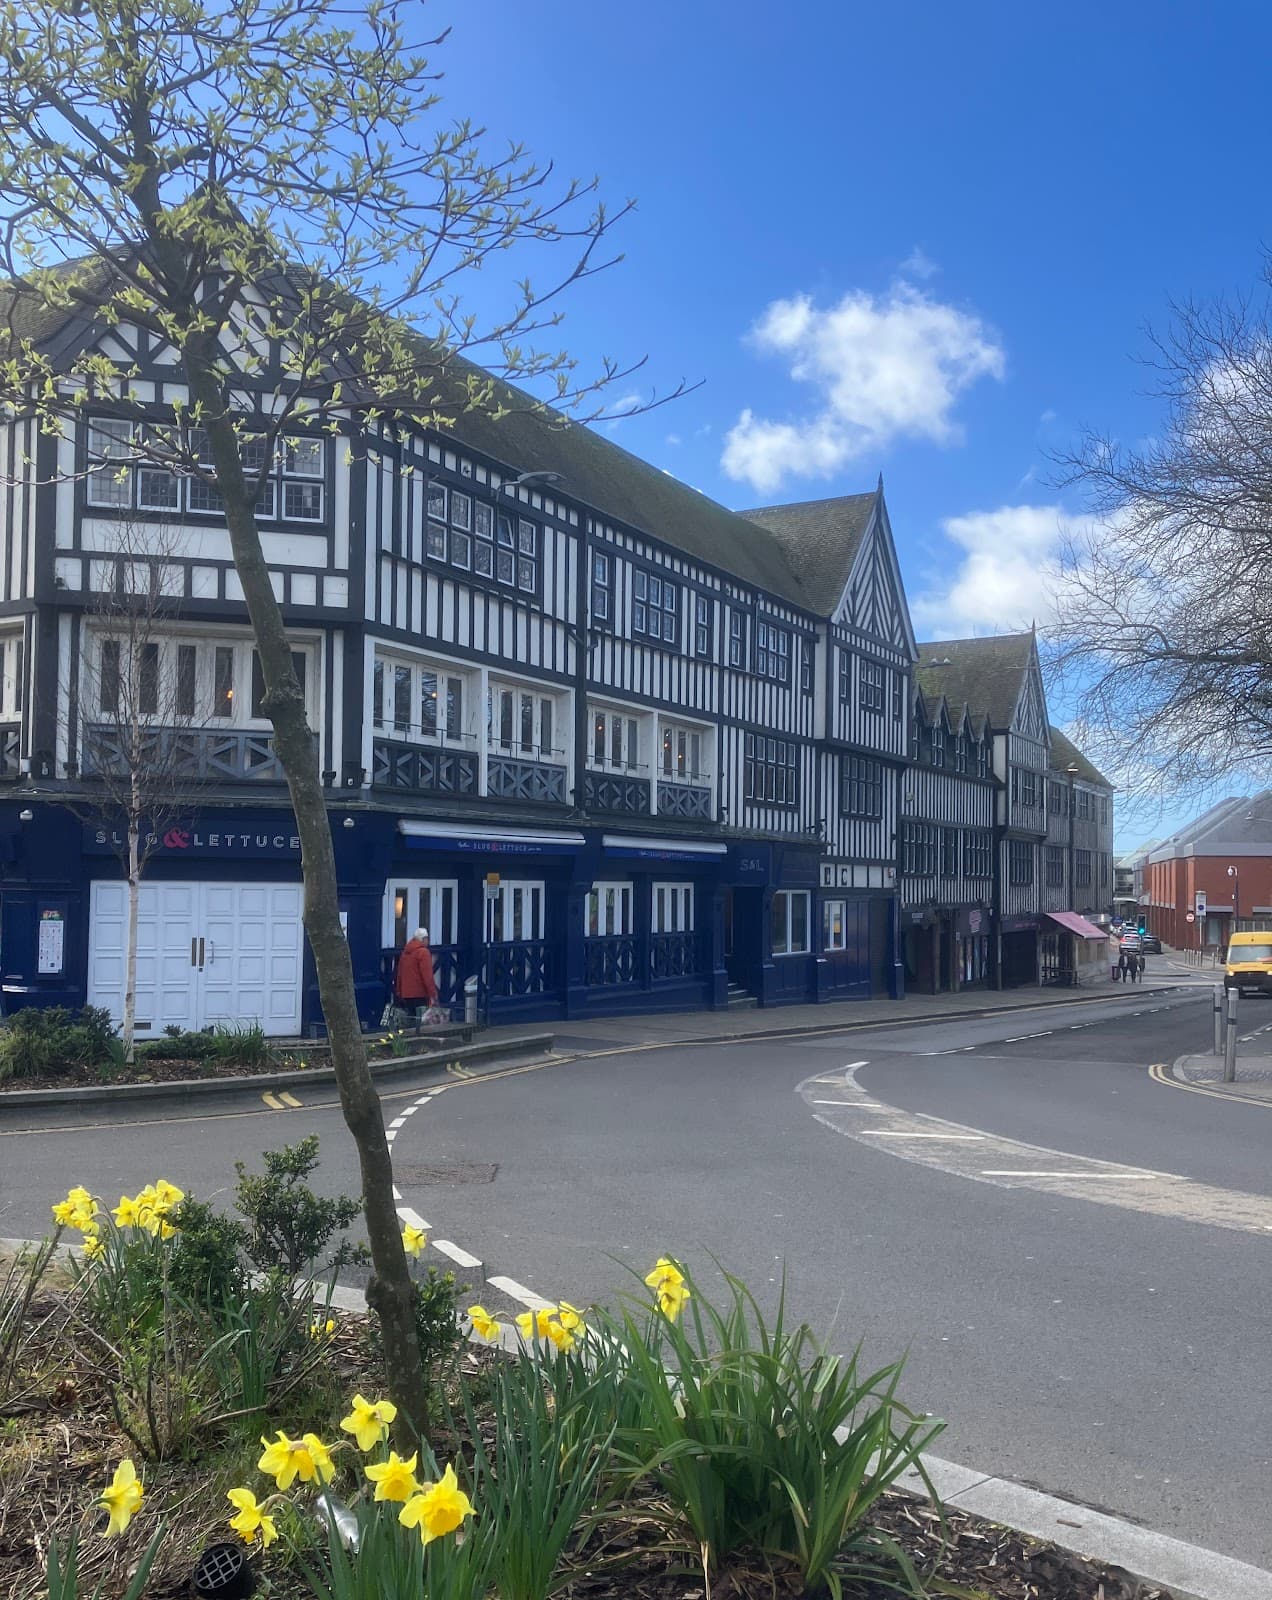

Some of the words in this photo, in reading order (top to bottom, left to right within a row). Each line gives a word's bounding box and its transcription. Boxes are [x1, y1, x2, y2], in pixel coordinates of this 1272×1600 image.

[95, 831, 158, 845] SLG
[163, 827, 190, 849] &
[193, 833, 301, 849] LETTUCE
